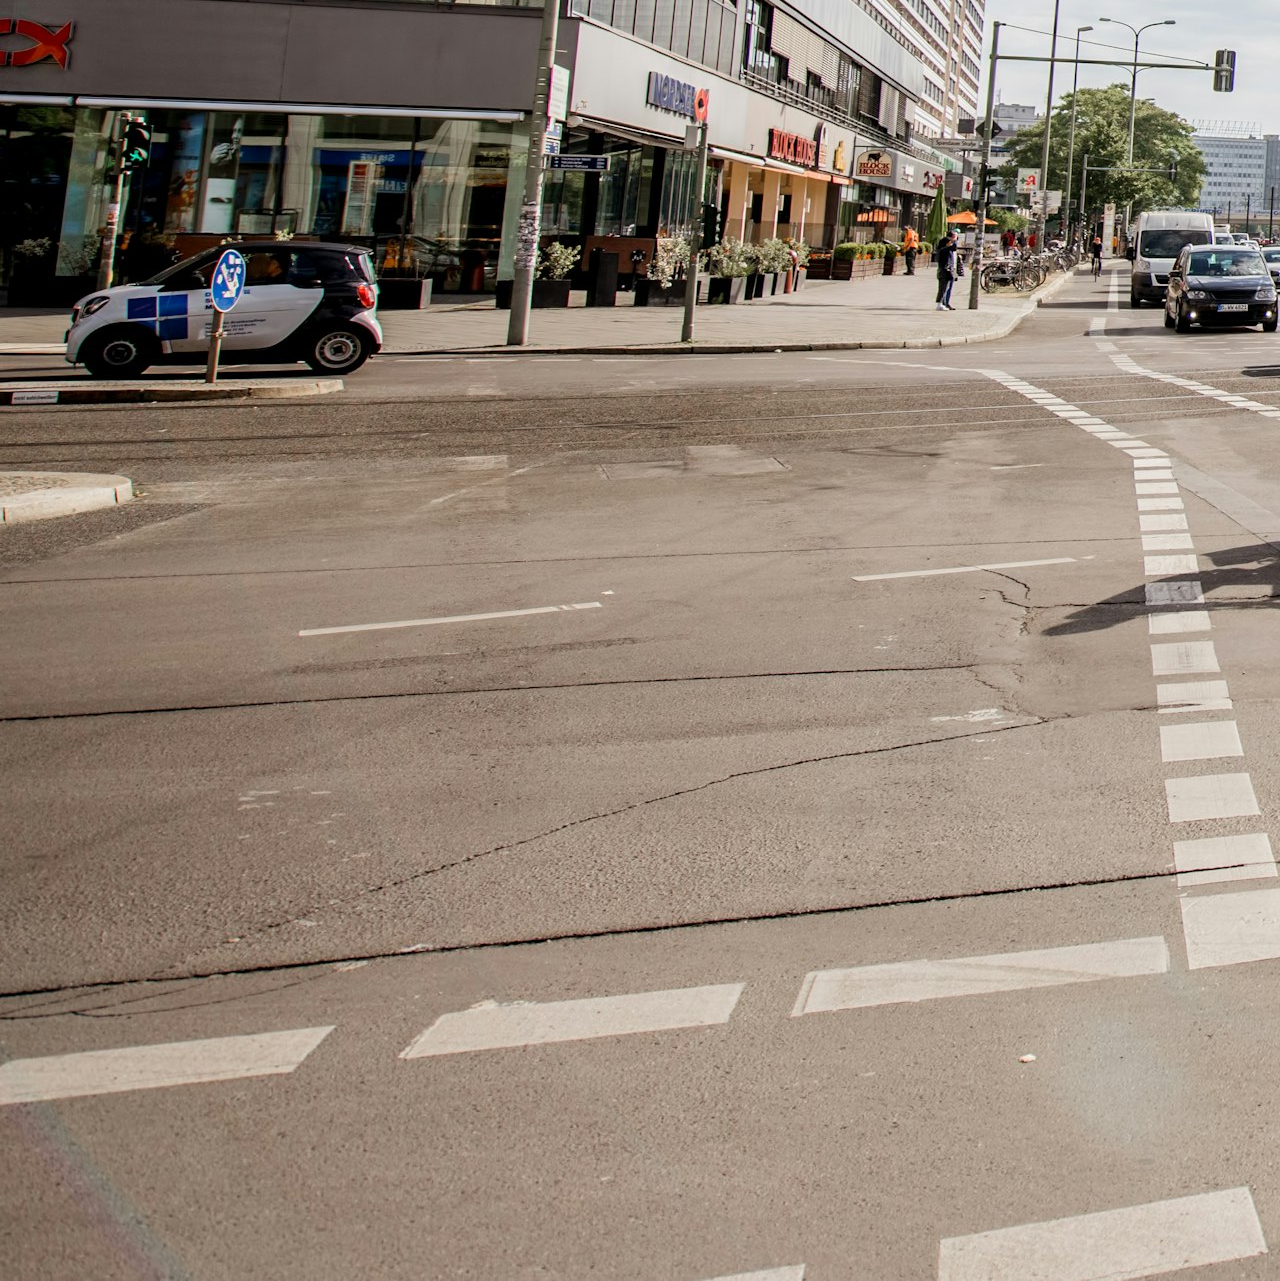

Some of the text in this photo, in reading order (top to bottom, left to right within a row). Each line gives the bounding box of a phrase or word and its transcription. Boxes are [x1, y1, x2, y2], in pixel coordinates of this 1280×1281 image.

[647, 72, 696, 117] NORDSEE
[769, 128, 795, 161] BLOCK
[795, 135, 817, 168] HOUSE
